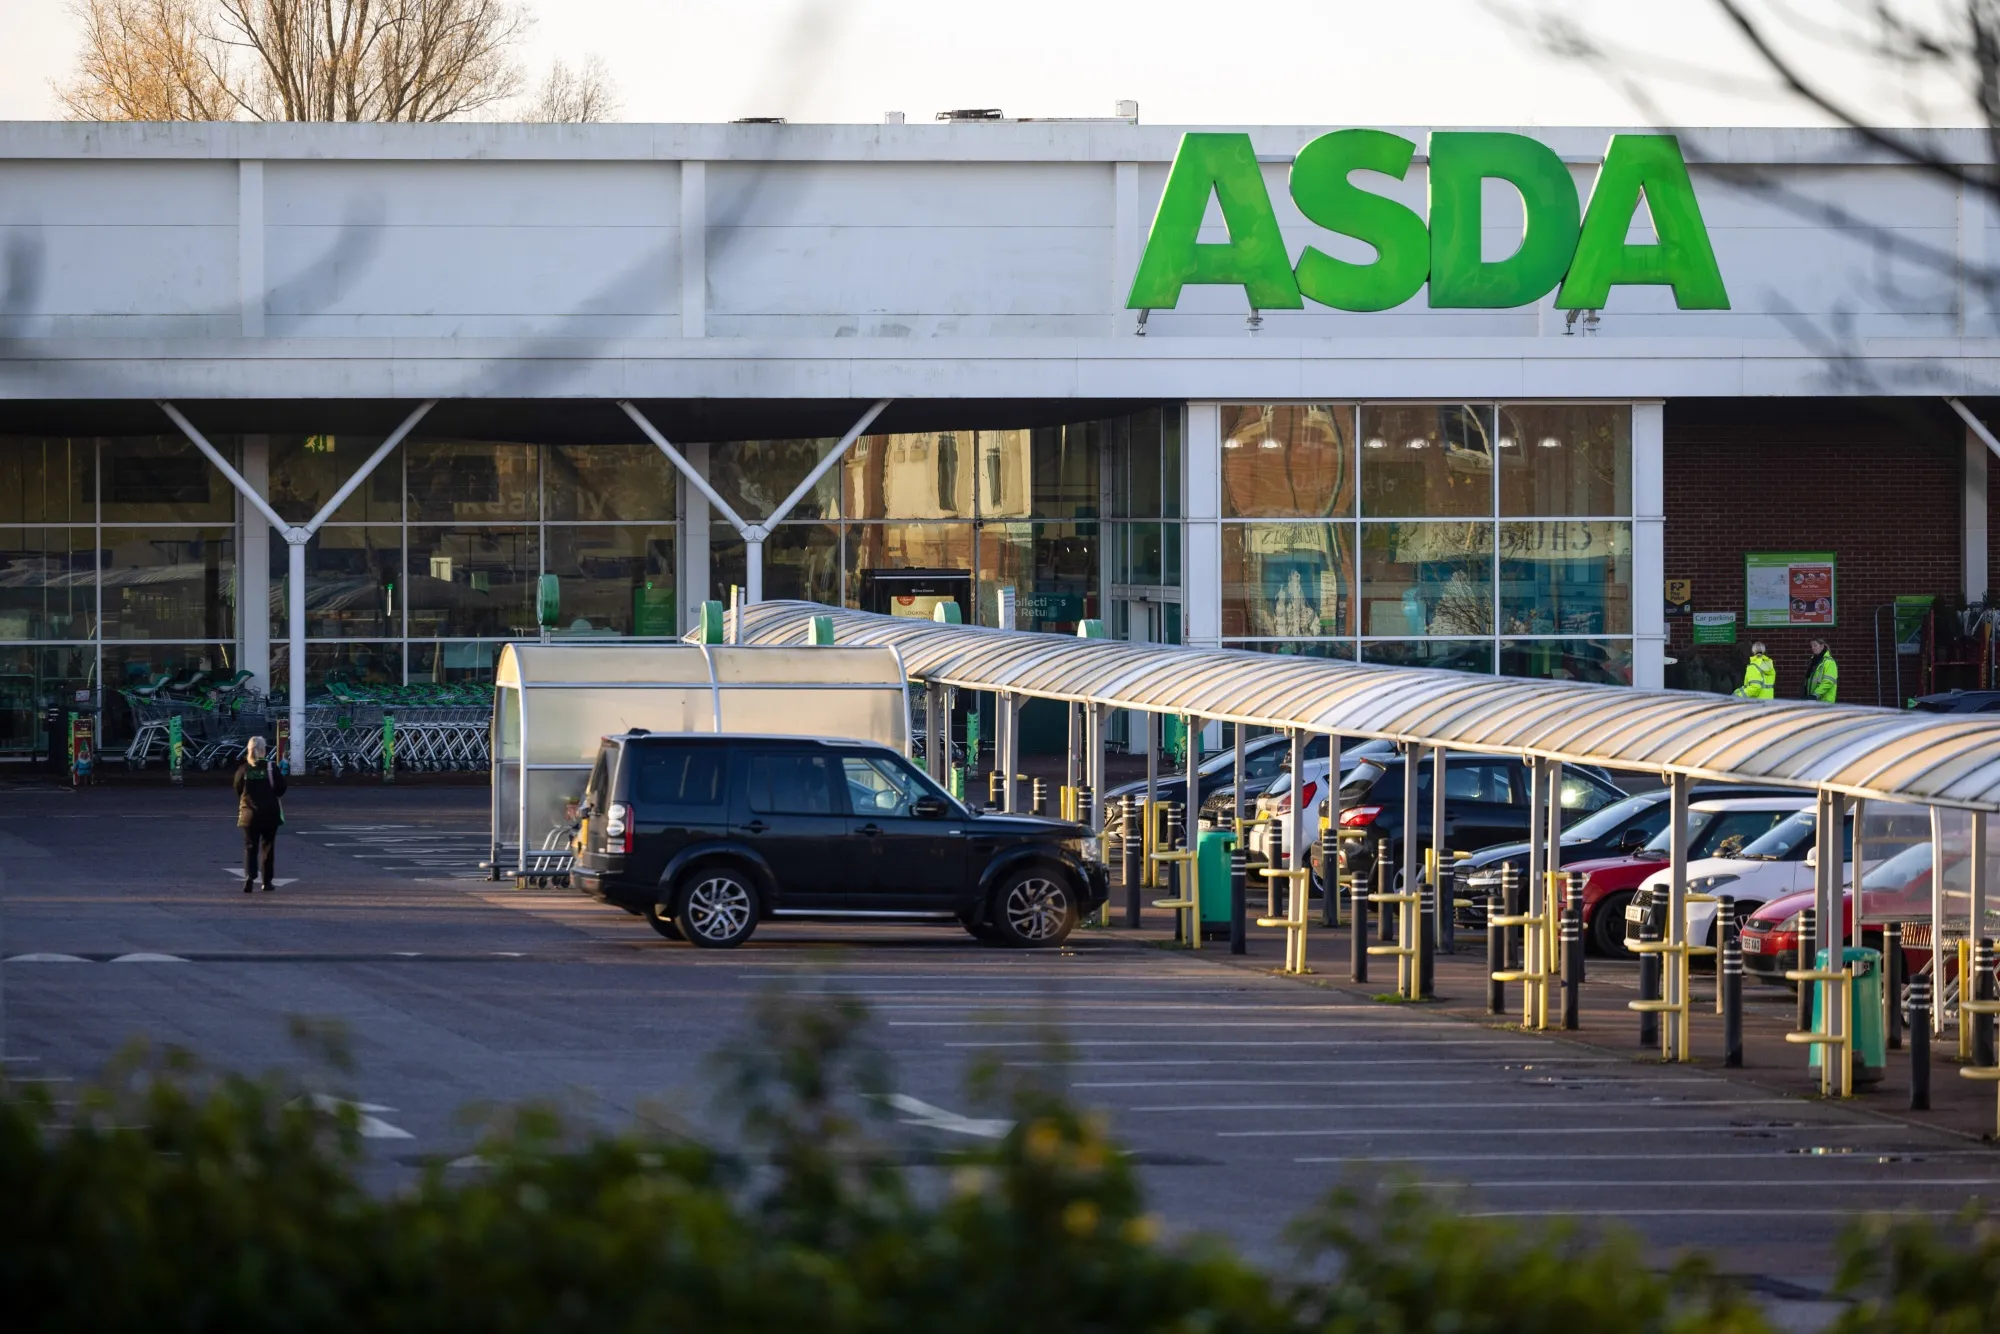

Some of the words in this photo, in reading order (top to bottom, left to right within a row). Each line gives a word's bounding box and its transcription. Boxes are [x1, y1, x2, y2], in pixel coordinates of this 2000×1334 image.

[1125, 129, 1731, 312] ASDA
[1015, 597, 1066, 607] ollectis
[1708, 614, 1734, 622] parking
